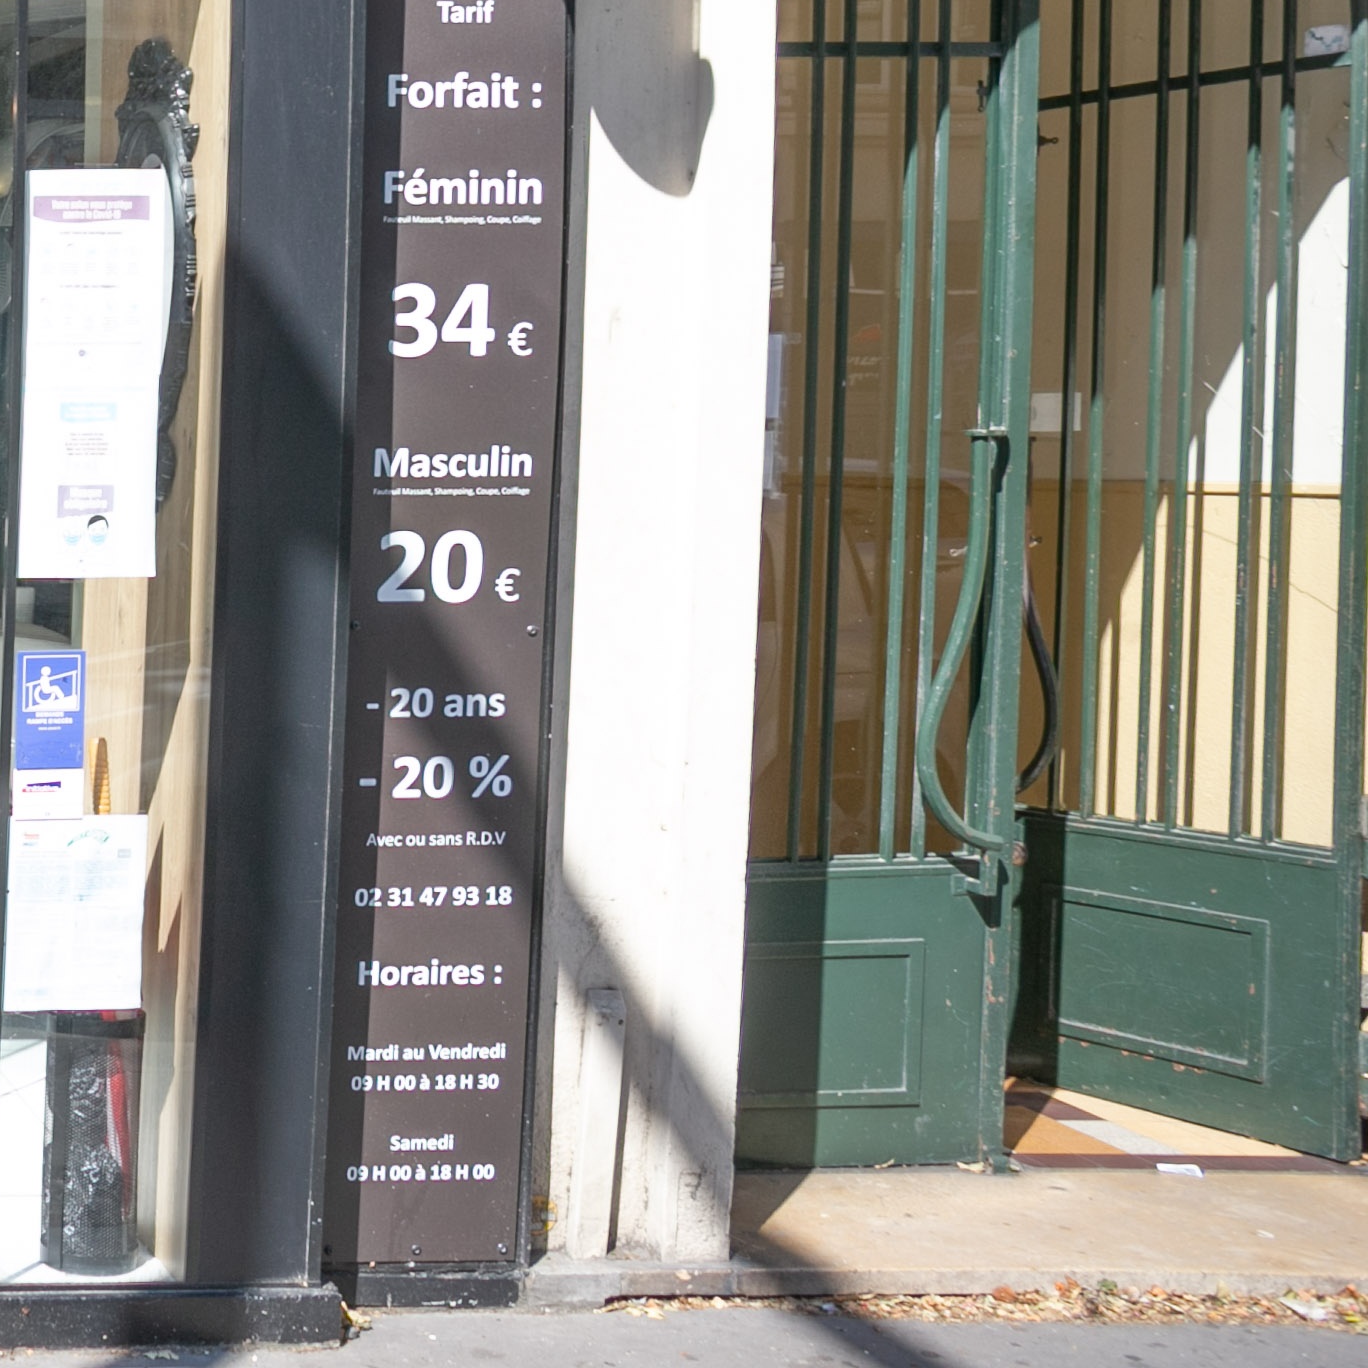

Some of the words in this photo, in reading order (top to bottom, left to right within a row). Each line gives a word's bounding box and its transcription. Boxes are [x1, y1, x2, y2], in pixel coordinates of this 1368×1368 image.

[436, 0, 495, 24] Tarif
[387, 72, 520, 109] Forfait
[383, 168, 543, 205] Féminin
[388, 282, 496, 358] 34
[507, 322, 534, 356] €
[373, 445, 533, 478] Masculin
[376, 529, 484, 604] 20
[494, 567, 522, 602] €
[389, 687, 434, 718] 20
[443, 692, 506, 718] ans
[391, 755, 455, 800] 20
[468, 753, 513, 799] %
[366, 833, 402, 847] Avec
[405, 834, 427, 847] ou
[429, 833, 463, 847] sans
[466, 831, 507, 846] R.D.V
[354, 887, 382, 907] 02
[387, 887, 414, 907] 31
[419, 886, 447, 906] 47
[452, 886, 480, 906] 93
[485, 885, 513, 906] 18
[358, 958, 485, 986] Horaires
[347, 1044, 400, 1061] Mardi
[402, 1047, 425, 1061] au
[428, 1042, 507, 1060] Vendredi
[351, 1075, 373, 1091] 09
[376, 1075, 391, 1091] H
[394, 1074, 416, 1091] 00
[419, 1073, 431, 1091] à
[434, 1074, 457, 1090] 18
[460, 1074, 473, 1090] H
[477, 1073, 500, 1090] 30
[389, 1134, 455, 1151] Samedi
[347, 1165, 369, 1182] 09
[372, 1165, 386, 1181] H
[389, 1165, 411, 1181] 00
[415, 1163, 426, 1181] à
[430, 1164, 452, 1181] 18
[455, 1164, 469, 1180] H
[472, 1163, 495, 1180] 00
